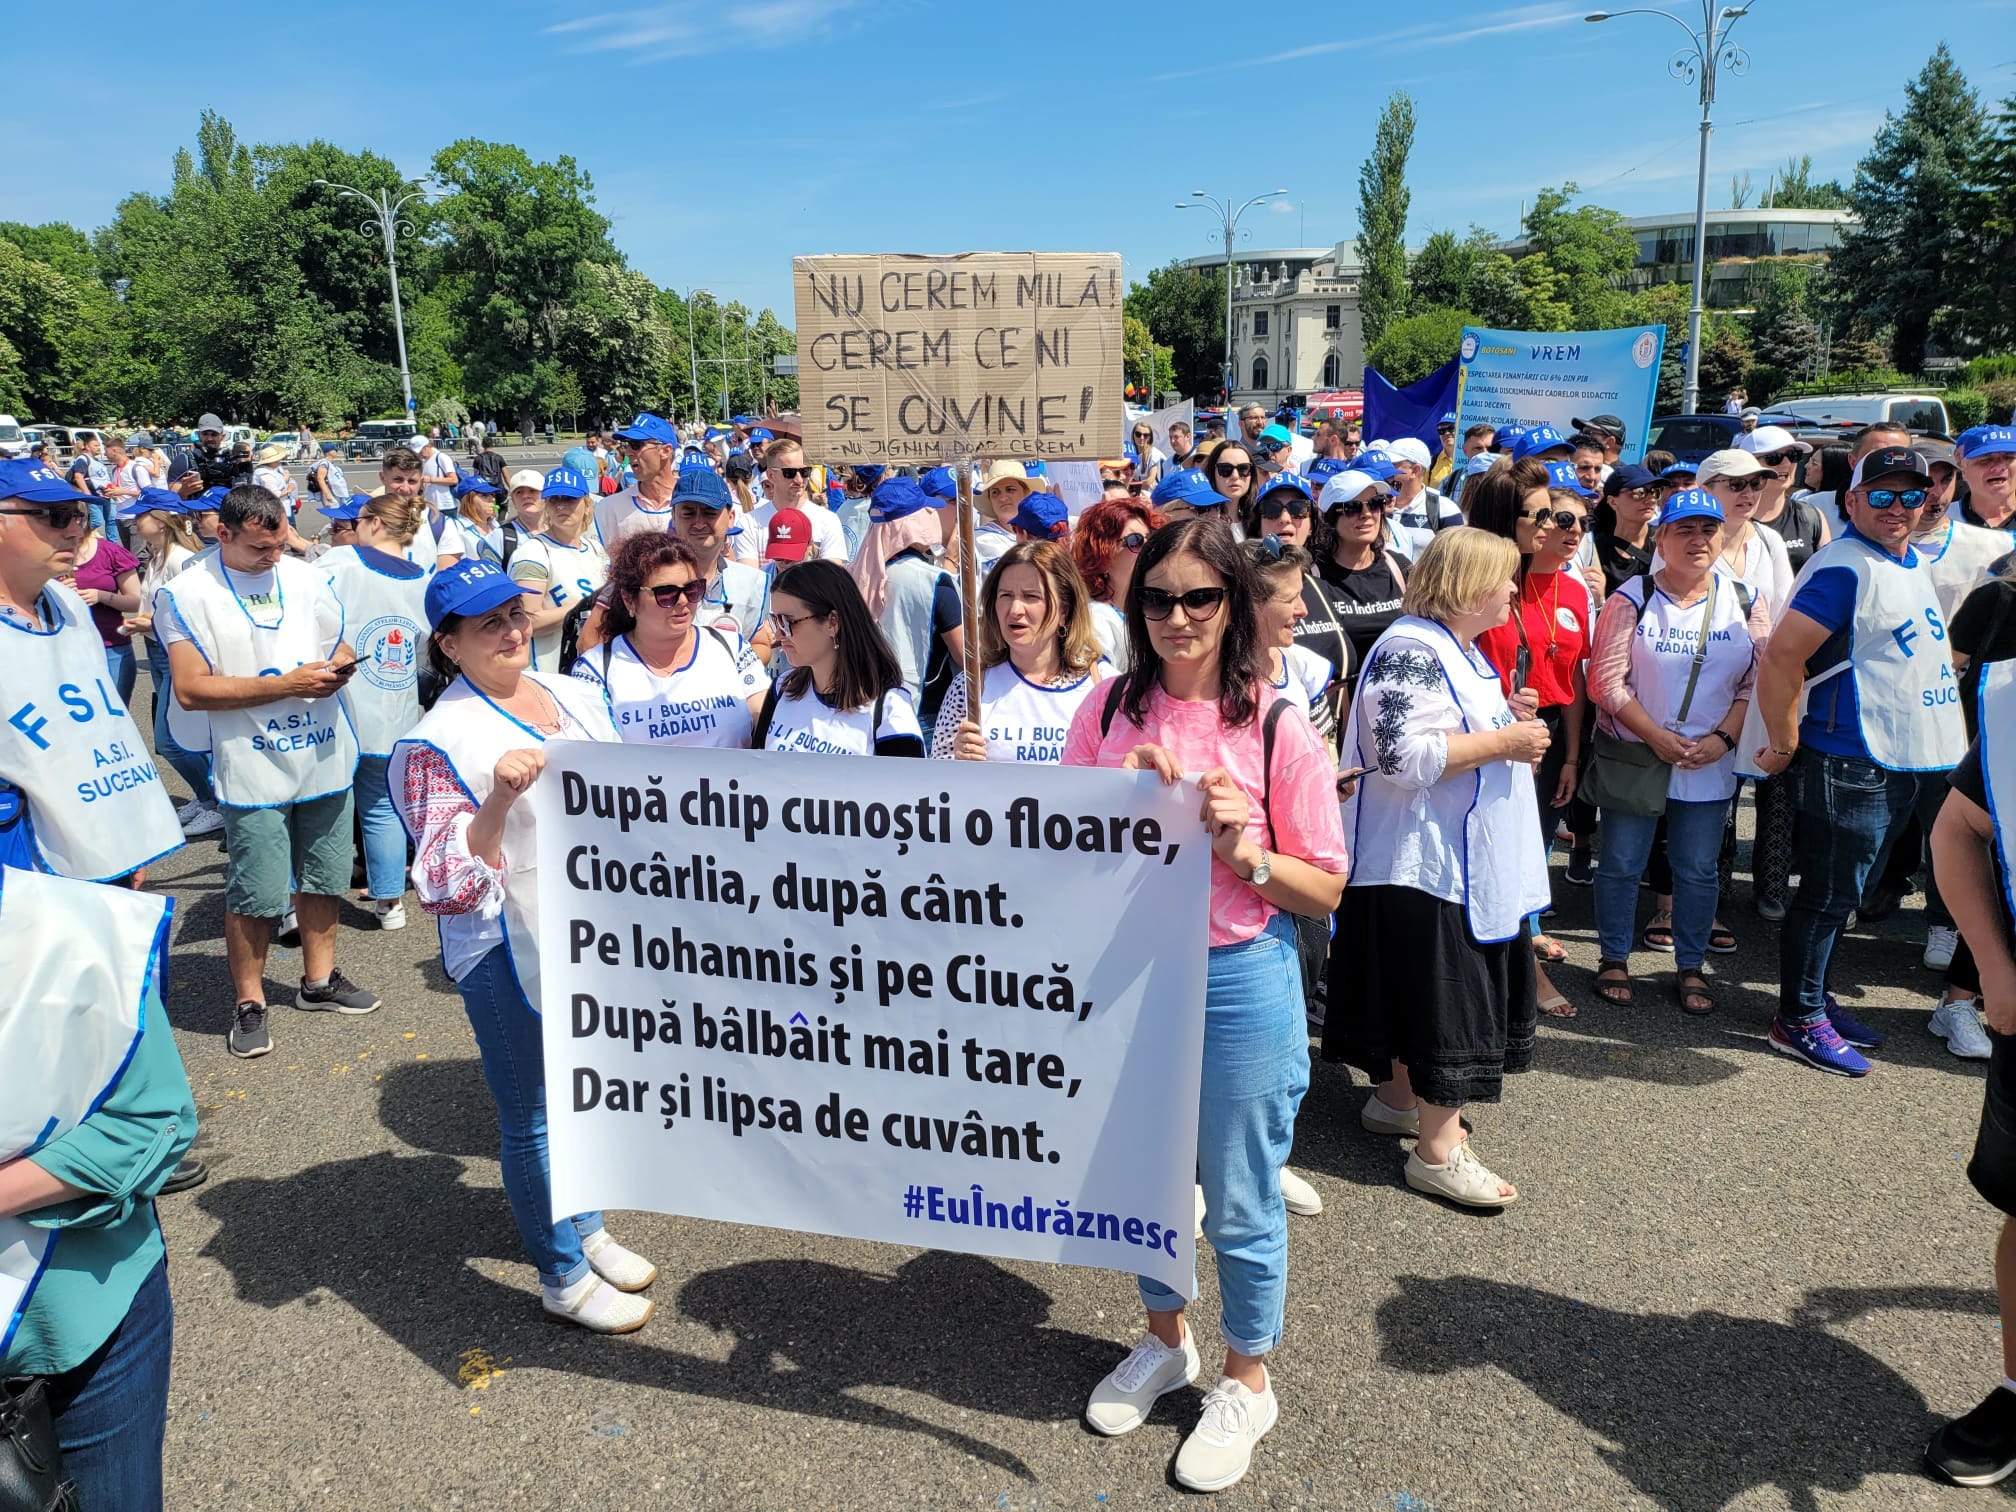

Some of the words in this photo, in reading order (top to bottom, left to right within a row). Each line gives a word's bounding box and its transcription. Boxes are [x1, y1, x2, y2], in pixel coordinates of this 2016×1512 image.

[809, 272, 864, 317] NU
[881, 268, 996, 313] CEREM
[810, 327, 951, 372] CEREM
[975, 326, 1021, 369] CE
[1036, 326, 1069, 368] NI
[1531, 344, 1581, 361] VREM
[1484, 401, 1512, 409] DECENTE
[1545, 389, 1580, 398] CADRELOR
[1581, 391, 1619, 399] DIDACTICE
[825, 394, 873, 433] SE
[898, 385, 1094, 447] CUVINE!
[1982, 431, 2011, 442] FSLI
[686, 454, 707, 467] FSLI
[548, 471, 578, 487] FSLI
[1677, 490, 1717, 509] FSLI
[459, 563, 500, 585] FSLI
[1669, 628, 1732, 642] BUCOINA
[1655, 641, 1708, 656] RĂDĂUI
[661, 694, 736, 718] BUCOVINA
[267, 711, 317, 733] A.S.I.
[649, 713, 717, 739] RĂDĂUȚI
[252, 726, 336, 752] SUCEAVA
[794, 731, 852, 755] BUCOVI
[93, 741, 134, 768] A.S.I.
[562, 771, 667, 833] După
[680, 778, 770, 843] chip
[781, 791, 950, 856] cunoști
[965, 809, 992, 847] o
[1006, 797, 1180, 866] floare,
[567, 845, 760, 914] Ciocârlia,
[773, 862, 887, 928] după
[901, 874, 1023, 929] cânt.
[571, 920, 620, 966] Pe
[633, 923, 818, 987] Iohannis
[830, 944, 863, 1005] și
[877, 957, 933, 1008] pe
[947, 955, 1093, 1022] Ciucă,
[572, 994, 681, 1053] După
[693, 1003, 850, 1066] bâlbâit
[864, 1029, 949, 1078] mai
[962, 1038, 1081, 1098] tare,
[574, 1068, 649, 1113] Dar
[660, 1075, 690, 1130] și
[703, 1076, 802, 1139] lipsa
[815, 1093, 869, 1143] de
[883, 1110, 1060, 1165] cuvânt.
[903, 1184, 1178, 1260] #EuÎndrăznesc
